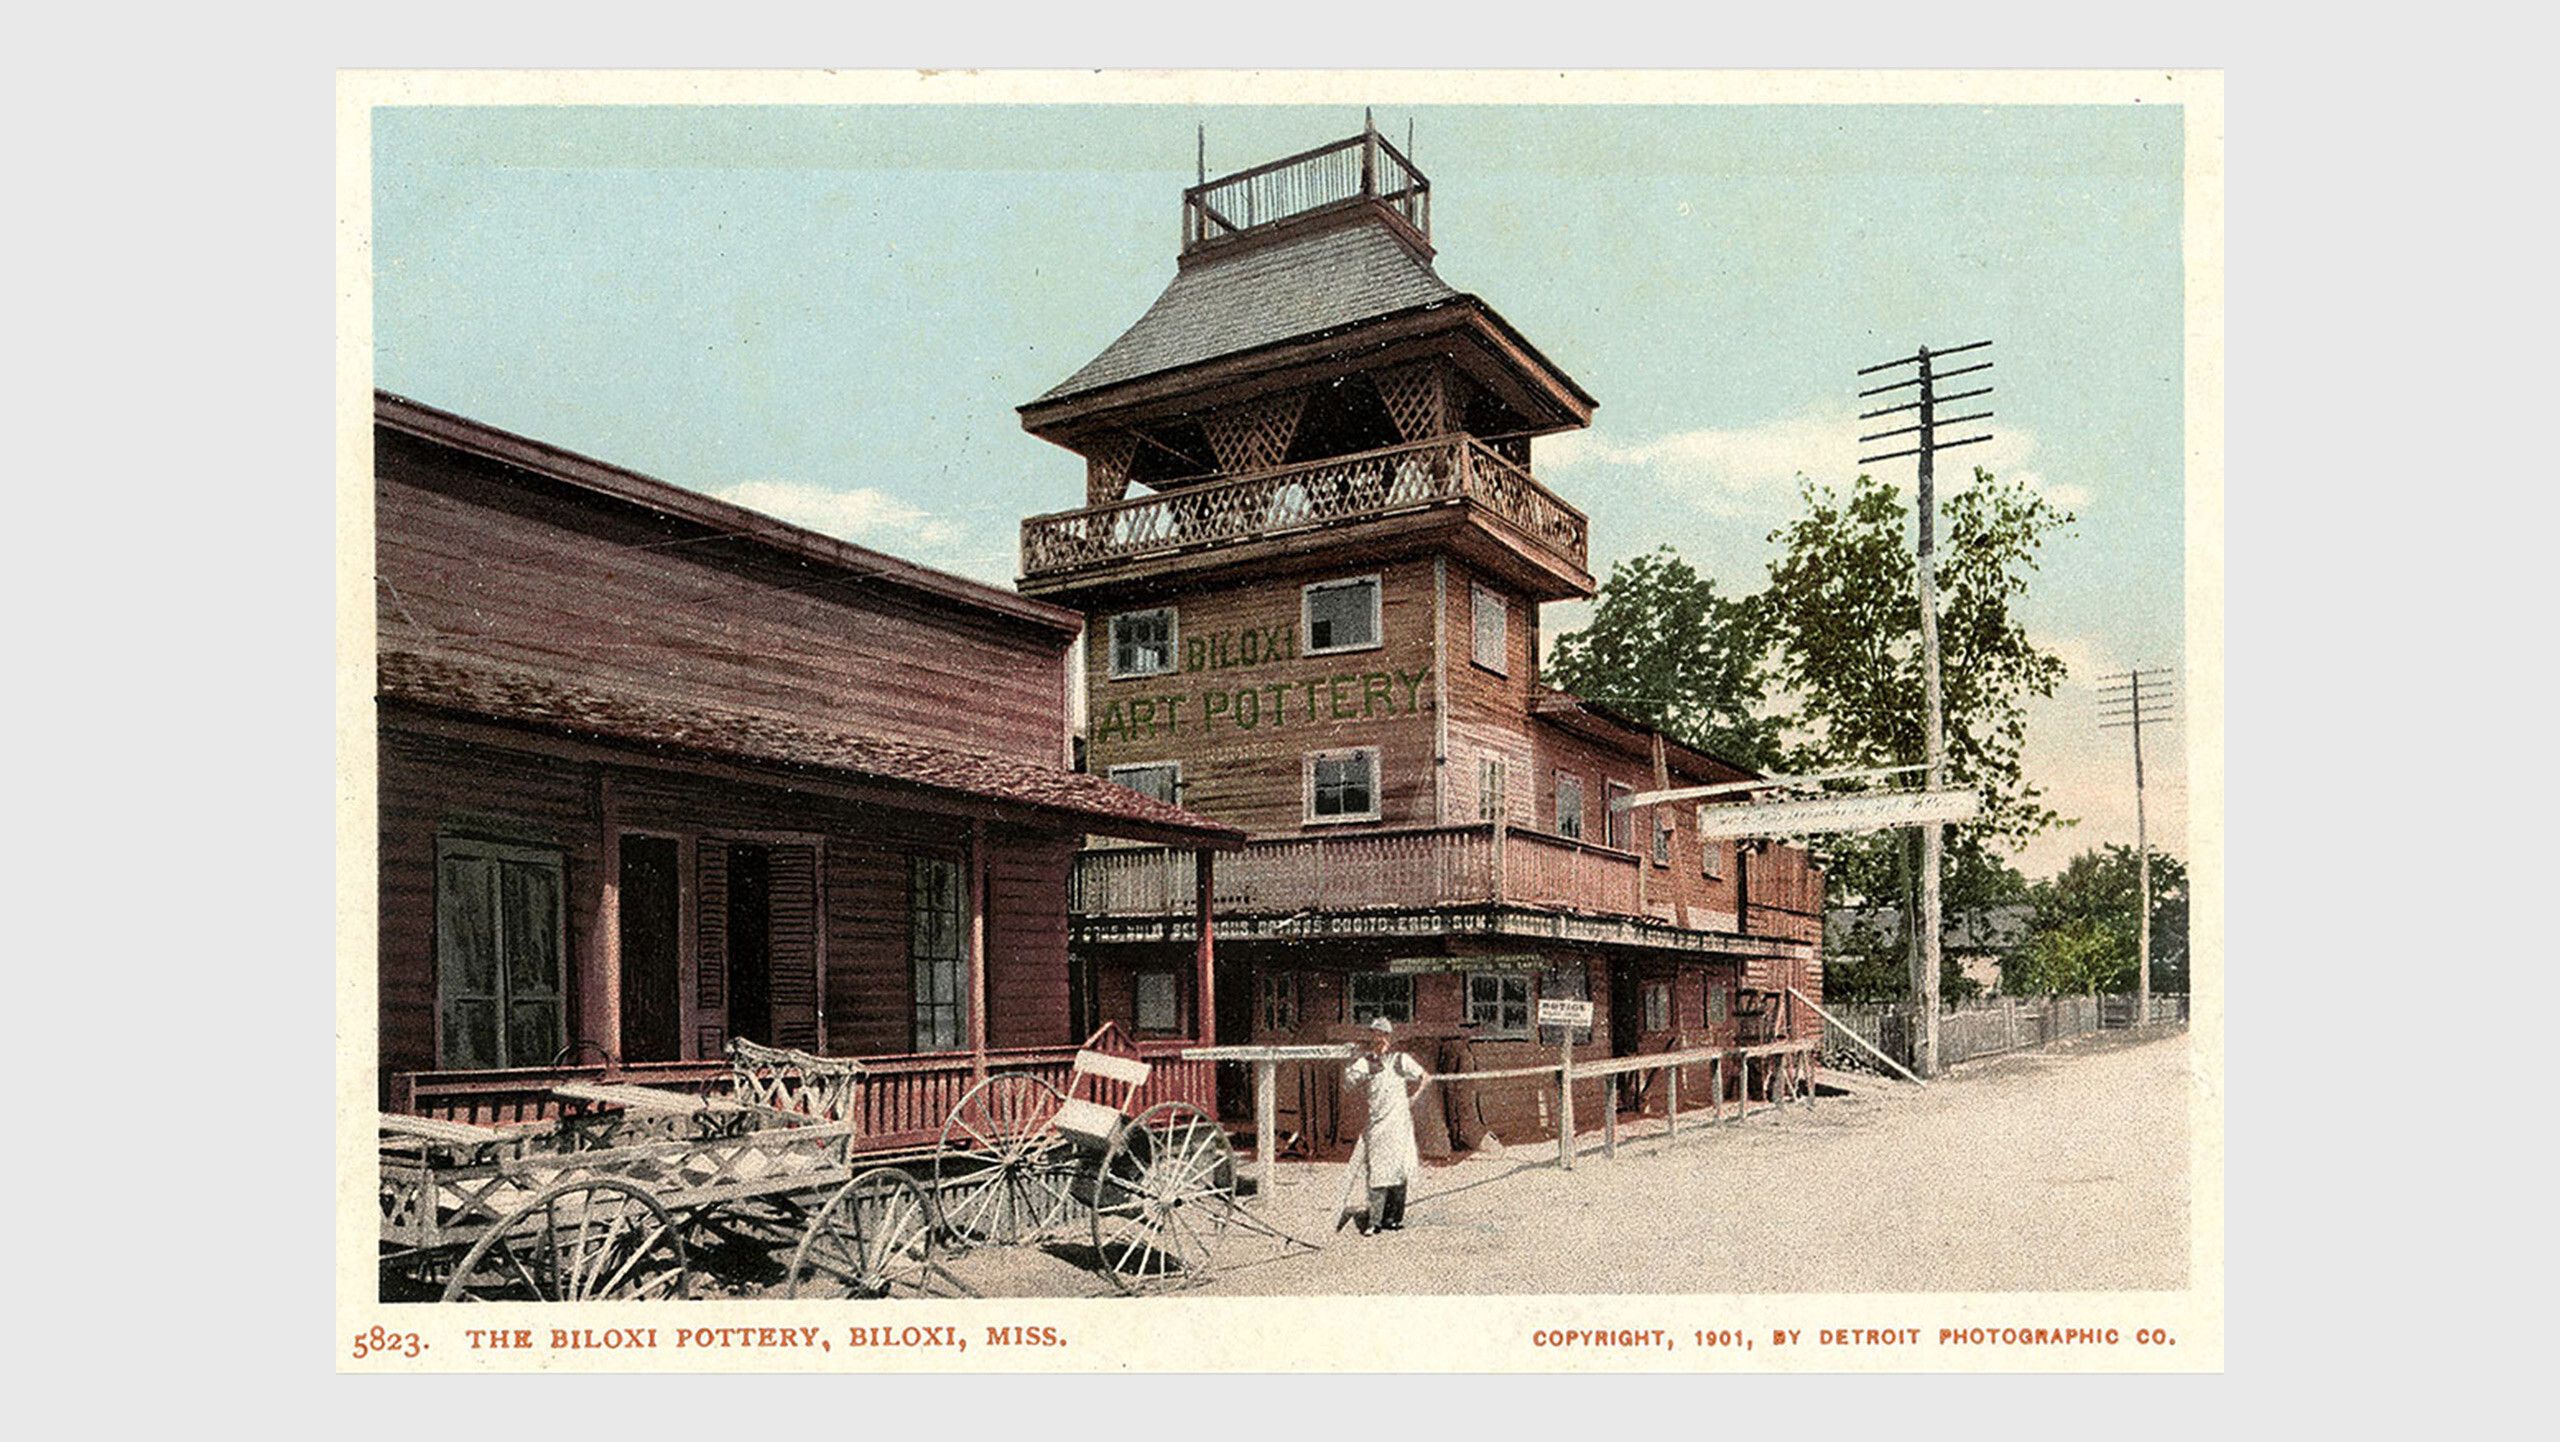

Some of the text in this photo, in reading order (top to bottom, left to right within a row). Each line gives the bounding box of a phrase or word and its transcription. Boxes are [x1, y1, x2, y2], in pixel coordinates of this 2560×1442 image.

[1187, 624, 1294, 671] BILOXI
[1098, 665, 1430, 743] ART POTTERY
